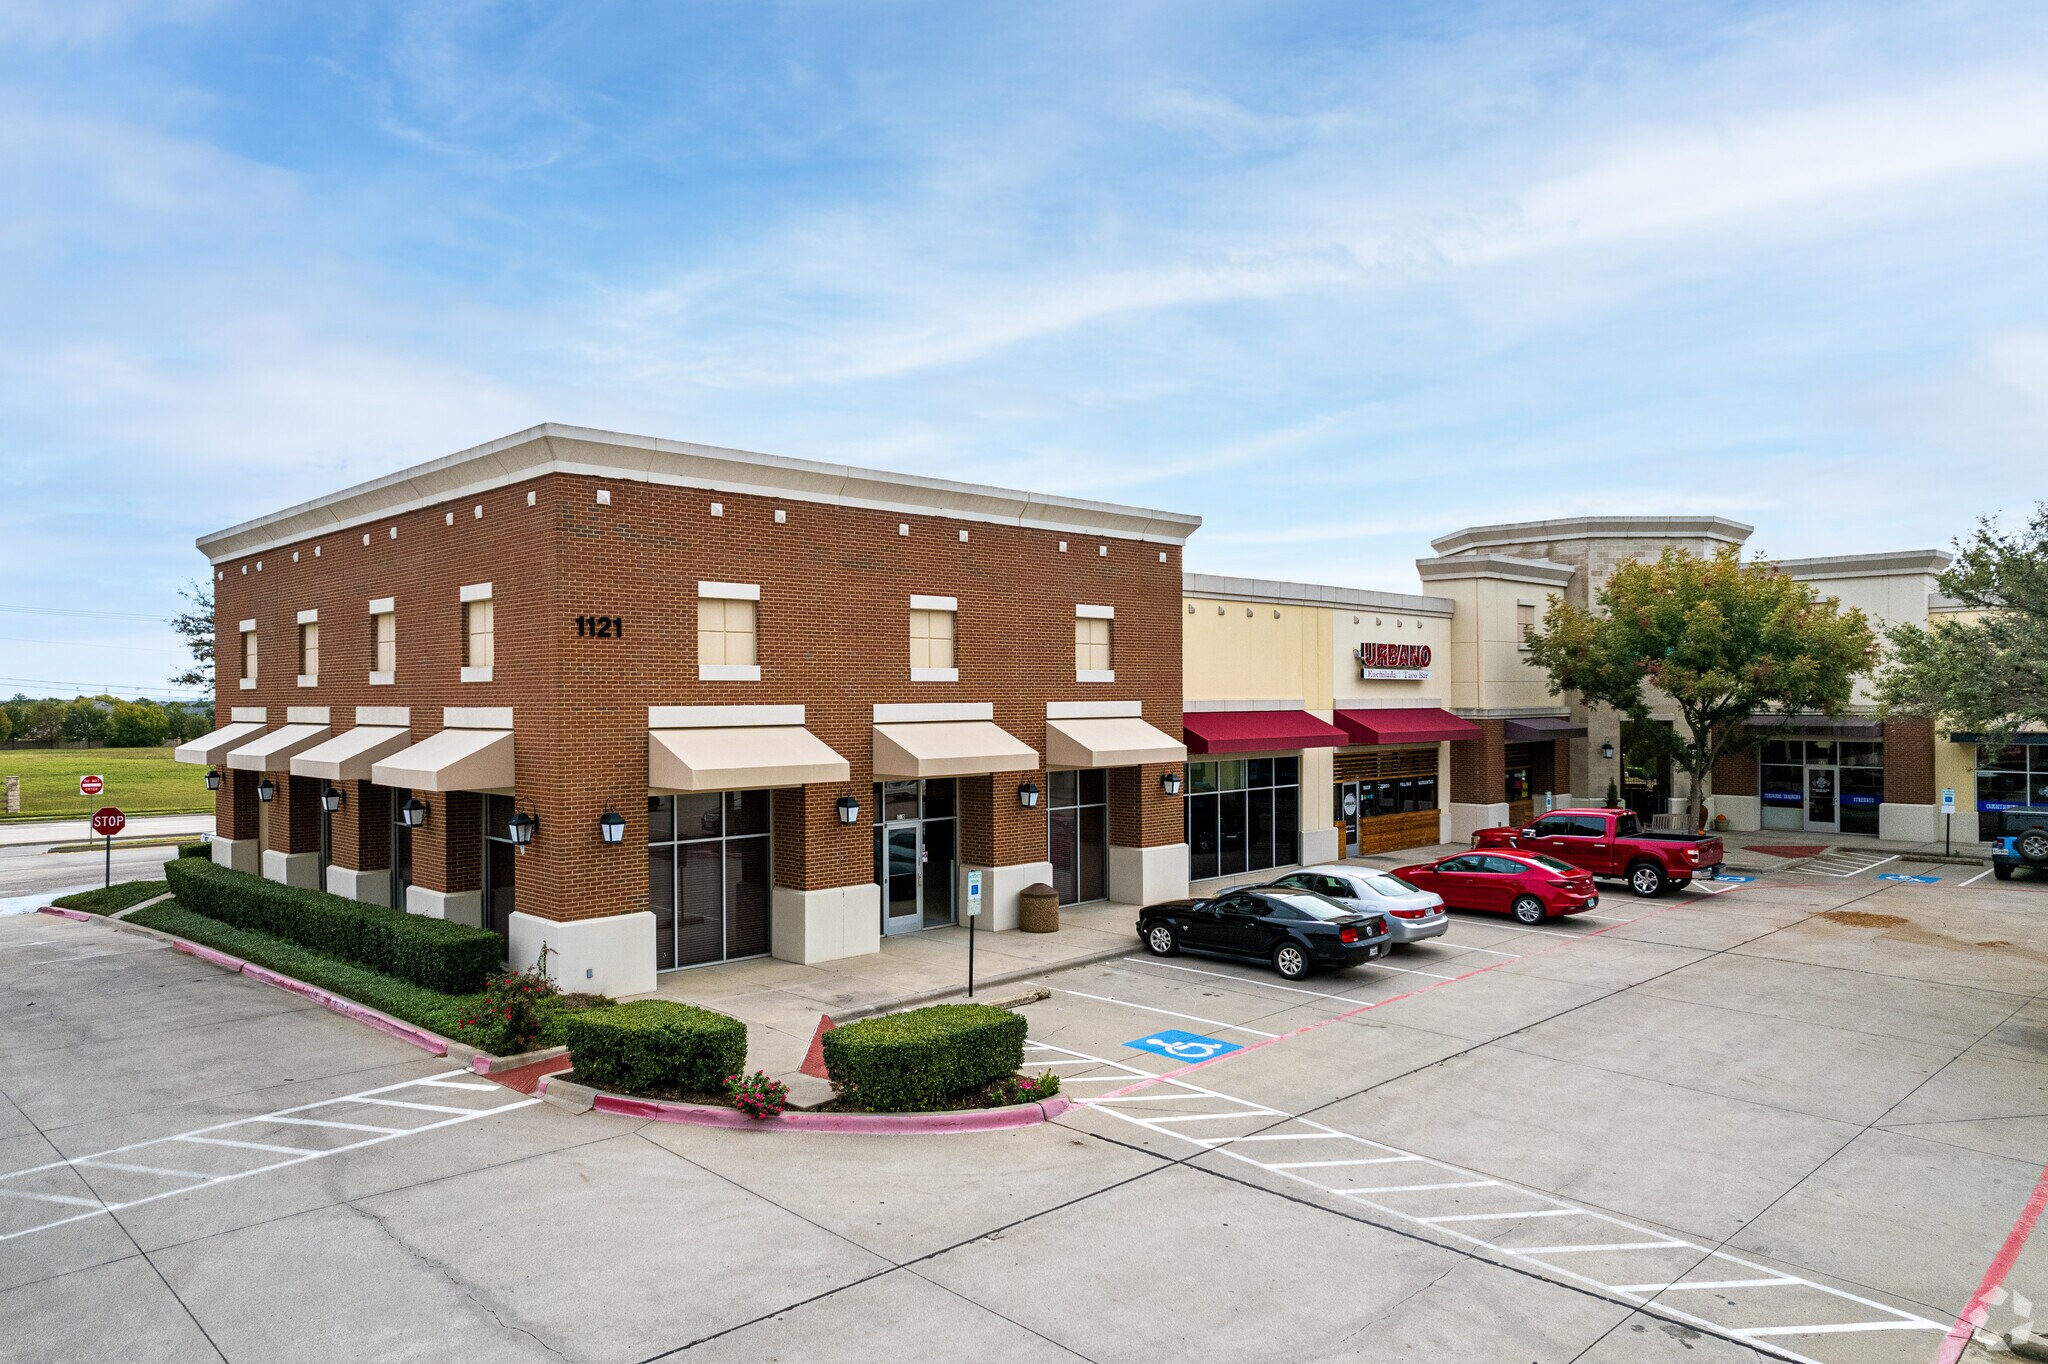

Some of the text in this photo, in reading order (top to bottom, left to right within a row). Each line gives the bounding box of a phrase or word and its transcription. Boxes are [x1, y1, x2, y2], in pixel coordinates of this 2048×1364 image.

[575, 616, 622, 638] 1121
[1362, 643, 1432, 667] URBANO
[1367, 670, 1429, 679] Enchilada Taco Bar
[94, 815, 124, 827] STOP
